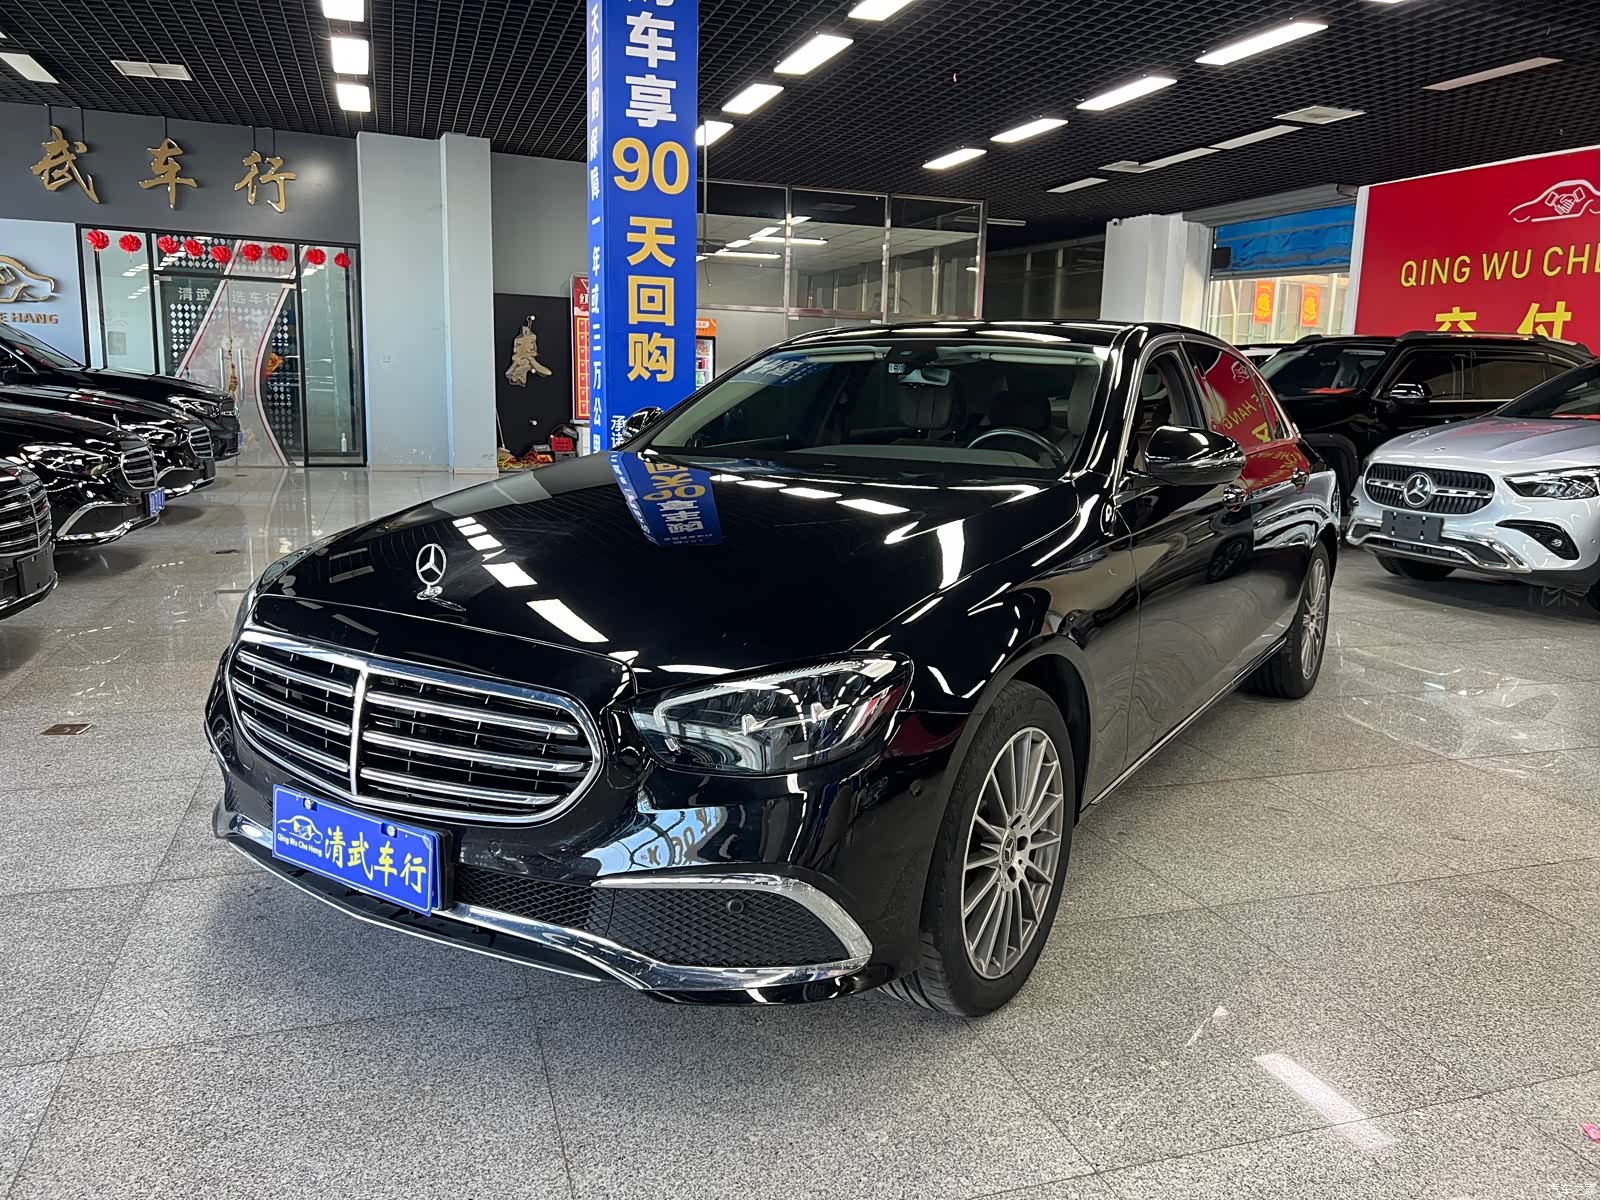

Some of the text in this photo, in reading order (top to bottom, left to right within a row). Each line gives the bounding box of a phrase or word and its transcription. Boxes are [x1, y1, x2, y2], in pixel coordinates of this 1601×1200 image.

[30, 125, 297, 213] 武车行
[611, 0, 690, 383] 车享90天回购
[1400, 255, 1471, 288] QING
[1481, 248, 1532, 281] WU
[178, 287, 279, 305] 清武选车行
[11, 312, 59, 325] HANG
[277, 833, 323, 858] Qing Wu Che Hang
[325, 825, 427, 894] 清武车行
